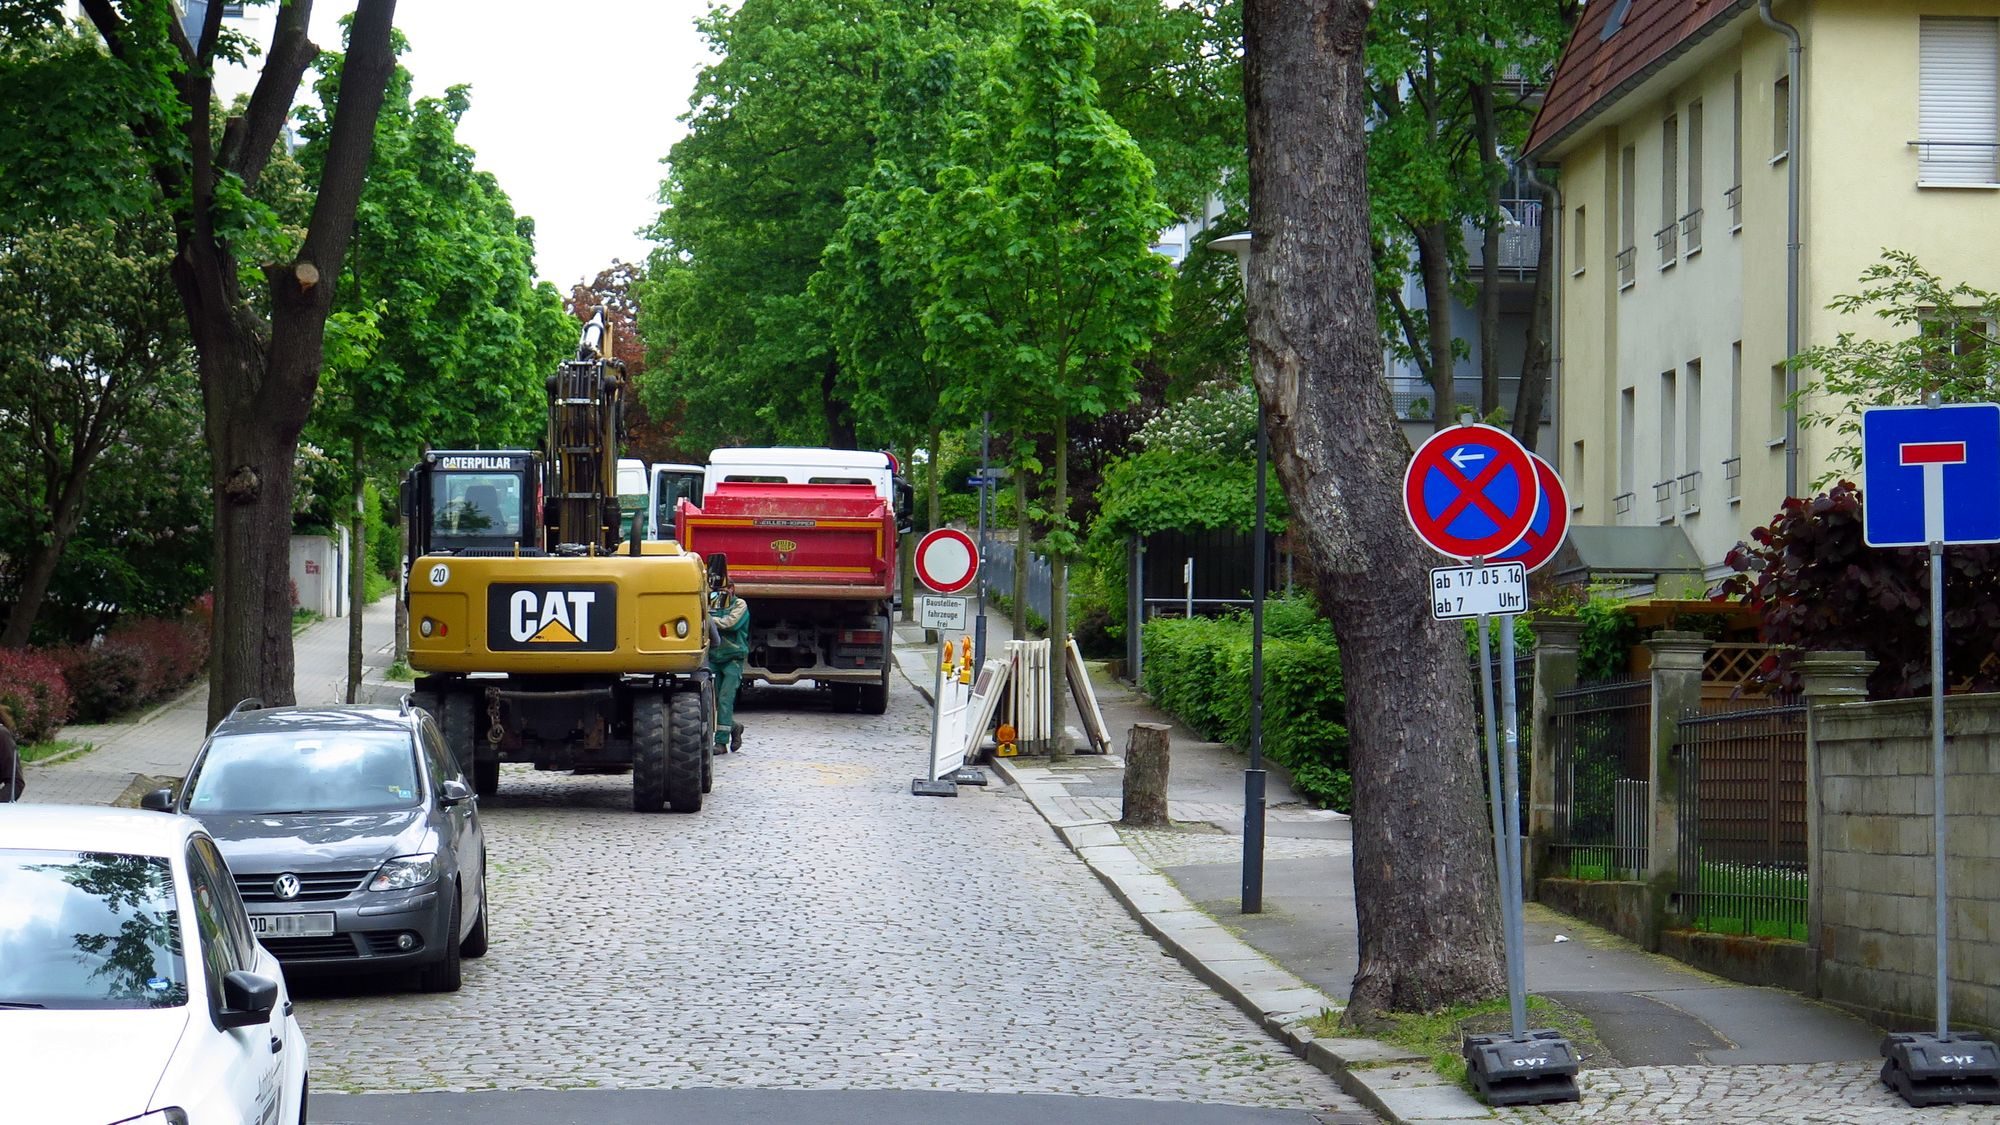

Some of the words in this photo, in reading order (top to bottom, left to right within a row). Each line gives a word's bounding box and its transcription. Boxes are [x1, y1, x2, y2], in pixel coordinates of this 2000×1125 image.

[443, 456, 511, 469] CATERPILLAR
[432, 568, 446, 583] 20
[1436, 576, 1451, 589] ab
[926, 599, 962, 608] Baustellen-
[1437, 598, 1452, 613] ab
[1457, 597, 1464, 612] 7
[1499, 592, 1521, 608] Uhr
[510, 590, 595, 643] CAT
[927, 610, 959, 621] fahrzeuge
[937, 620, 949, 628] frei
[1513, 1057, 1548, 1066] GVT
